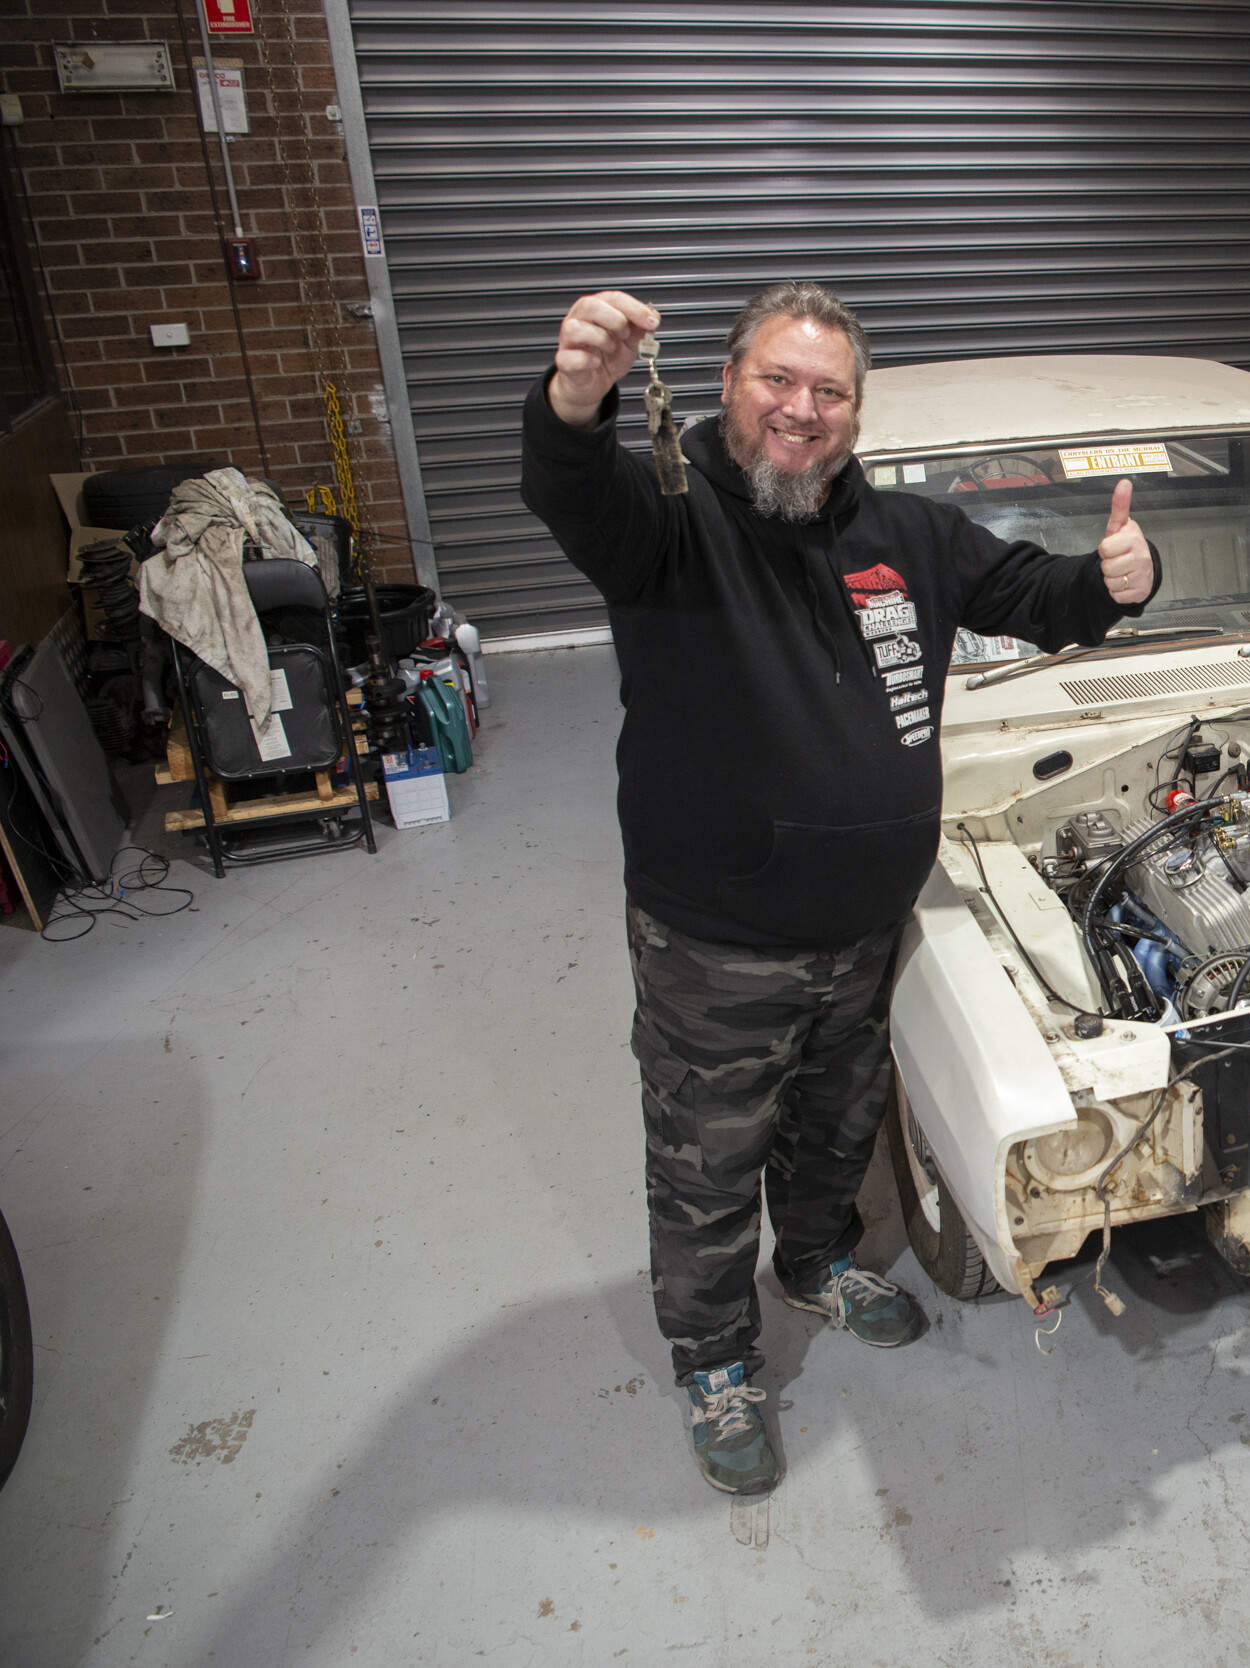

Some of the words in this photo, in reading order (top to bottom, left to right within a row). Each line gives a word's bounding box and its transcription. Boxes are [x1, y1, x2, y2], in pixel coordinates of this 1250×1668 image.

[1063, 449, 1103, 457] CHRYSLERS
[1090, 453, 1142, 469] ENTRANT
[862, 604, 910, 625] DRAG
[863, 617, 912, 632] CHALLENGE
[876, 643, 897, 659] TUFF
[890, 689, 928, 708] Haltech
